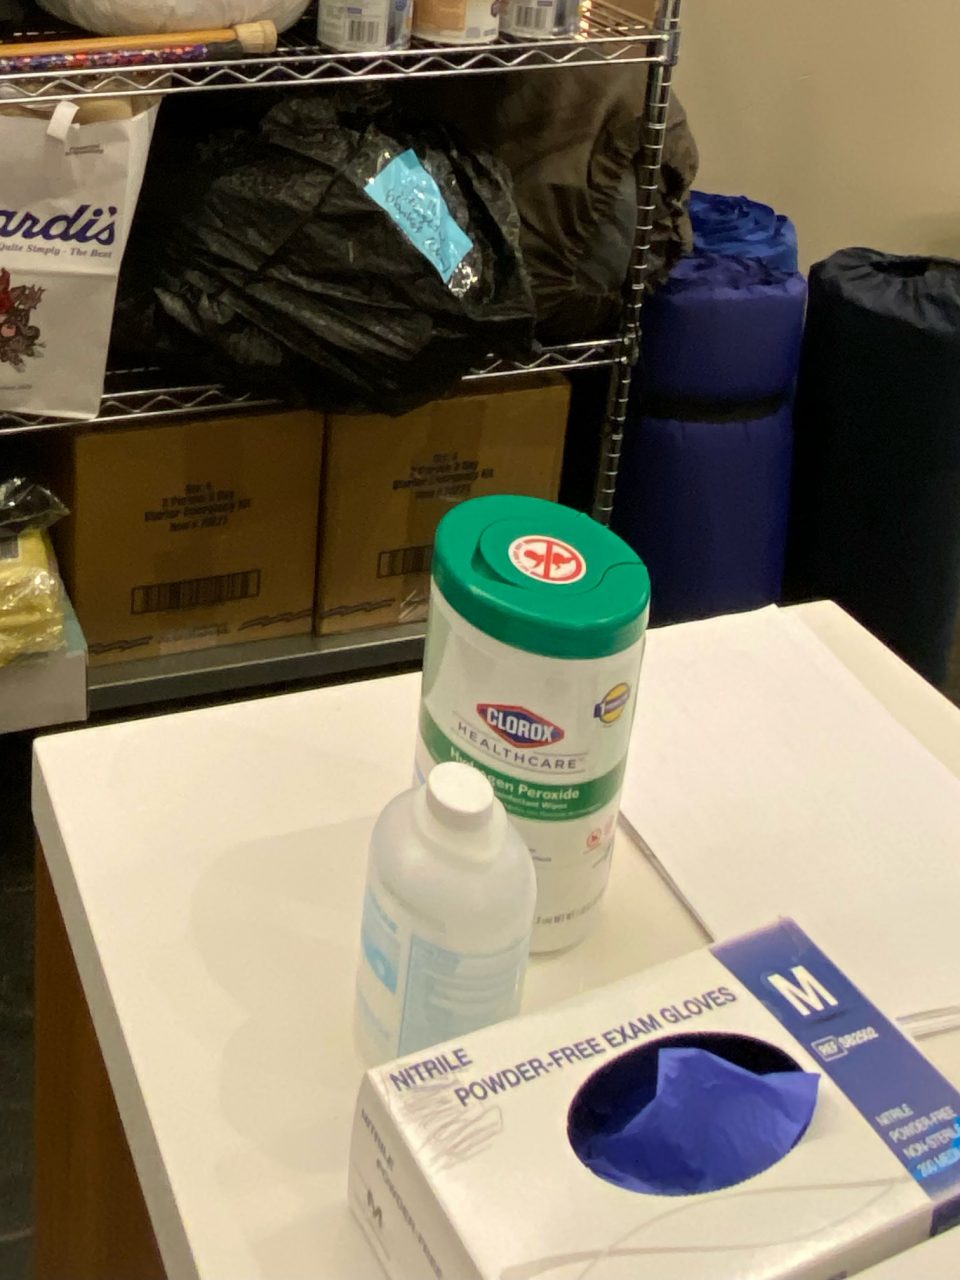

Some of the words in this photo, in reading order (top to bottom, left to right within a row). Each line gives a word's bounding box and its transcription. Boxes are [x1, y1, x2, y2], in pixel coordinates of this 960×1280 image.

[26, 244, 61, 256] Simply
[70, 247, 88, 257] The
[90, 249, 113, 259] Best
[486, 707, 555, 743] CLOROX
[458, 721, 577, 769] HEALTHCARE
[518, 784, 580, 801] Peroxide
[767, 965, 839, 1017] M
[453, 1037, 607, 1108] POWDER-FREE
[601, 1013, 664, 1050] EXAM
[659, 986, 738, 1026] GLOVES
[389, 1047, 474, 1093] NITRILE
[875, 1103, 915, 1127] NITRILE
[888, 1105, 958, 1144] POWDER-FREE
